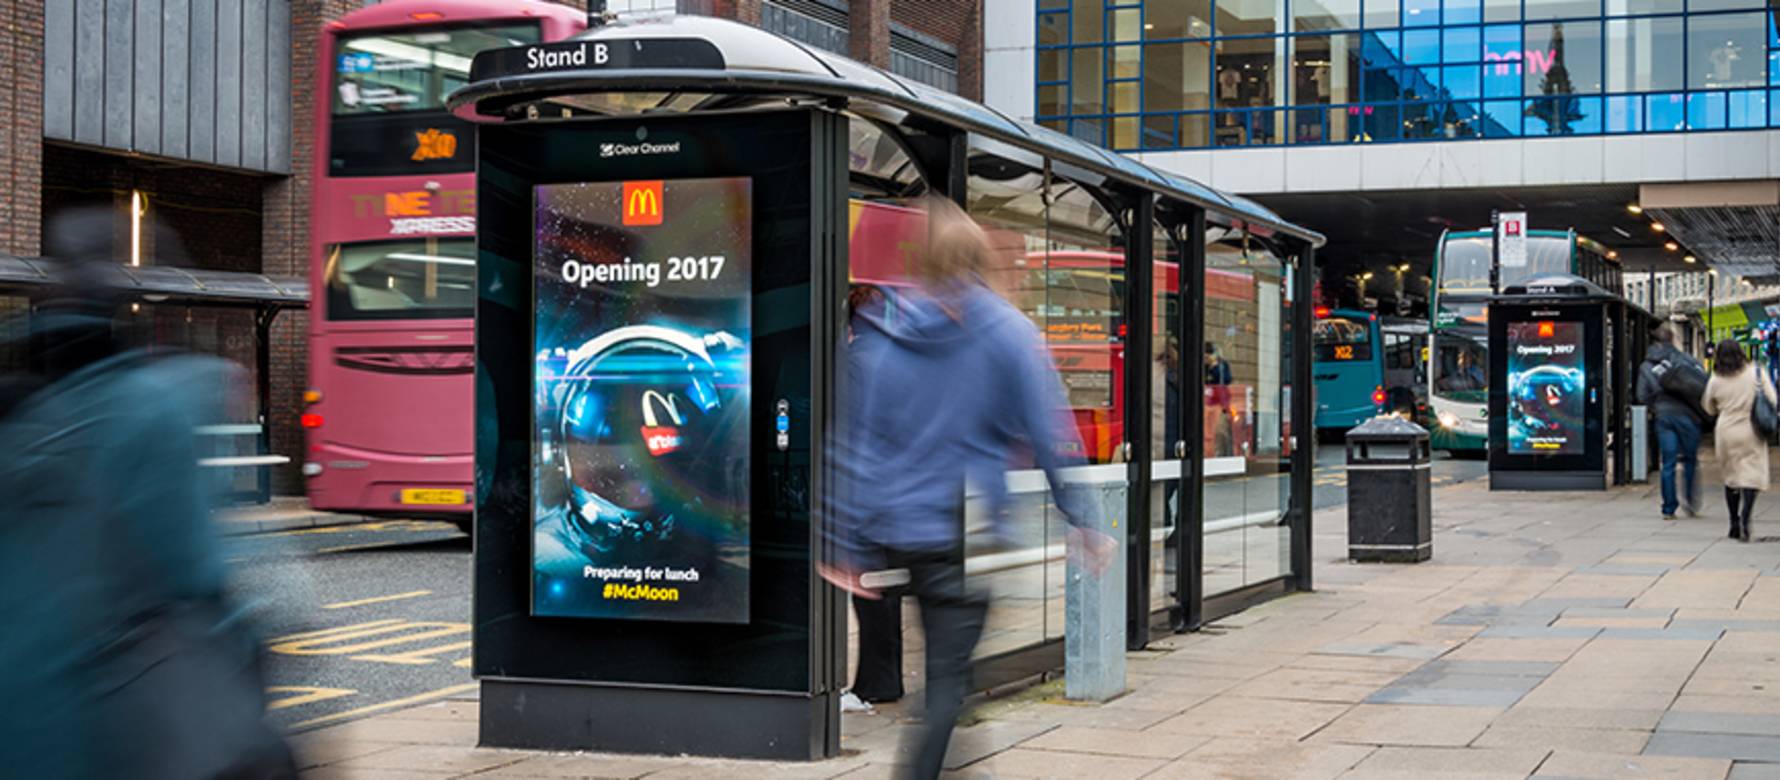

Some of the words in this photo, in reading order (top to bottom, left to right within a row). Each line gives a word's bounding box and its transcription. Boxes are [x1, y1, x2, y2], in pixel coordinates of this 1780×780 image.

[527, 43, 586, 68] Stand
[594, 43, 609, 64] B
[1484, 44, 1556, 76] hmv
[614, 144, 639, 156] Clear
[640, 142, 680, 153] Channel
[561, 256, 660, 288] Opening
[667, 257, 725, 280] 2017
[584, 565, 642, 582] Preparing
[644, 566, 663, 580] for
[664, 567, 699, 581] lunch
[602, 583, 679, 600] #McMoon
